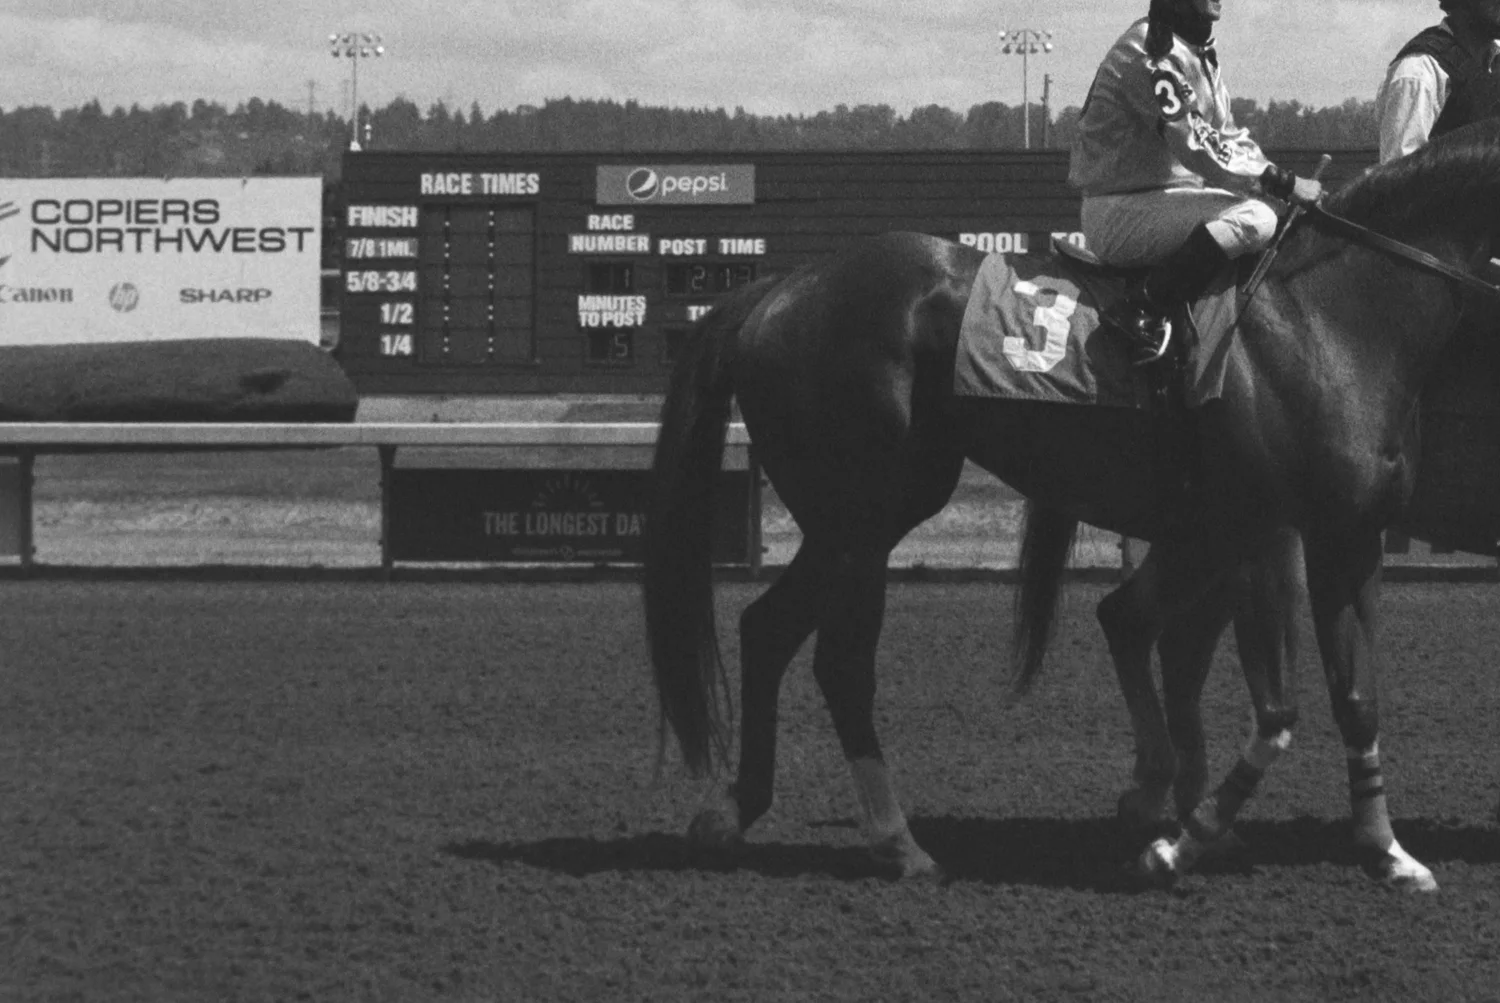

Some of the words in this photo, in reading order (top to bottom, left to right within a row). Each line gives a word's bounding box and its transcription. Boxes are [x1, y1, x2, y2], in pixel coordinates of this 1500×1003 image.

[1155, 79, 1181, 115] 3
[421, 173, 472, 195] RACE
[481, 173, 540, 195] TIMES
[662, 172, 728, 195] pepsi
[31, 199, 220, 224] COPIERS
[347, 206, 418, 227] FINISH
[588, 214, 634, 231] RACE
[31, 227, 314, 253] NORTHWEST
[350, 239, 375, 258] 7/8
[571, 234, 650, 252] NUMBER
[659, 238, 706, 255] POST
[719, 238, 766, 255] TIME
[960, 232, 1028, 253] POOL
[346, 271, 417, 291] 5/8-3/4
[180, 287, 272, 303] SHARP
[578, 296, 646, 312] MINUTES
[381, 303, 413, 324] 1/2
[580, 311, 601, 327] TO
[602, 311, 645, 328] POST
[381, 334, 412, 355] 1/4
[483, 511, 519, 535] THE
[525, 511, 610, 536] LONGEST
